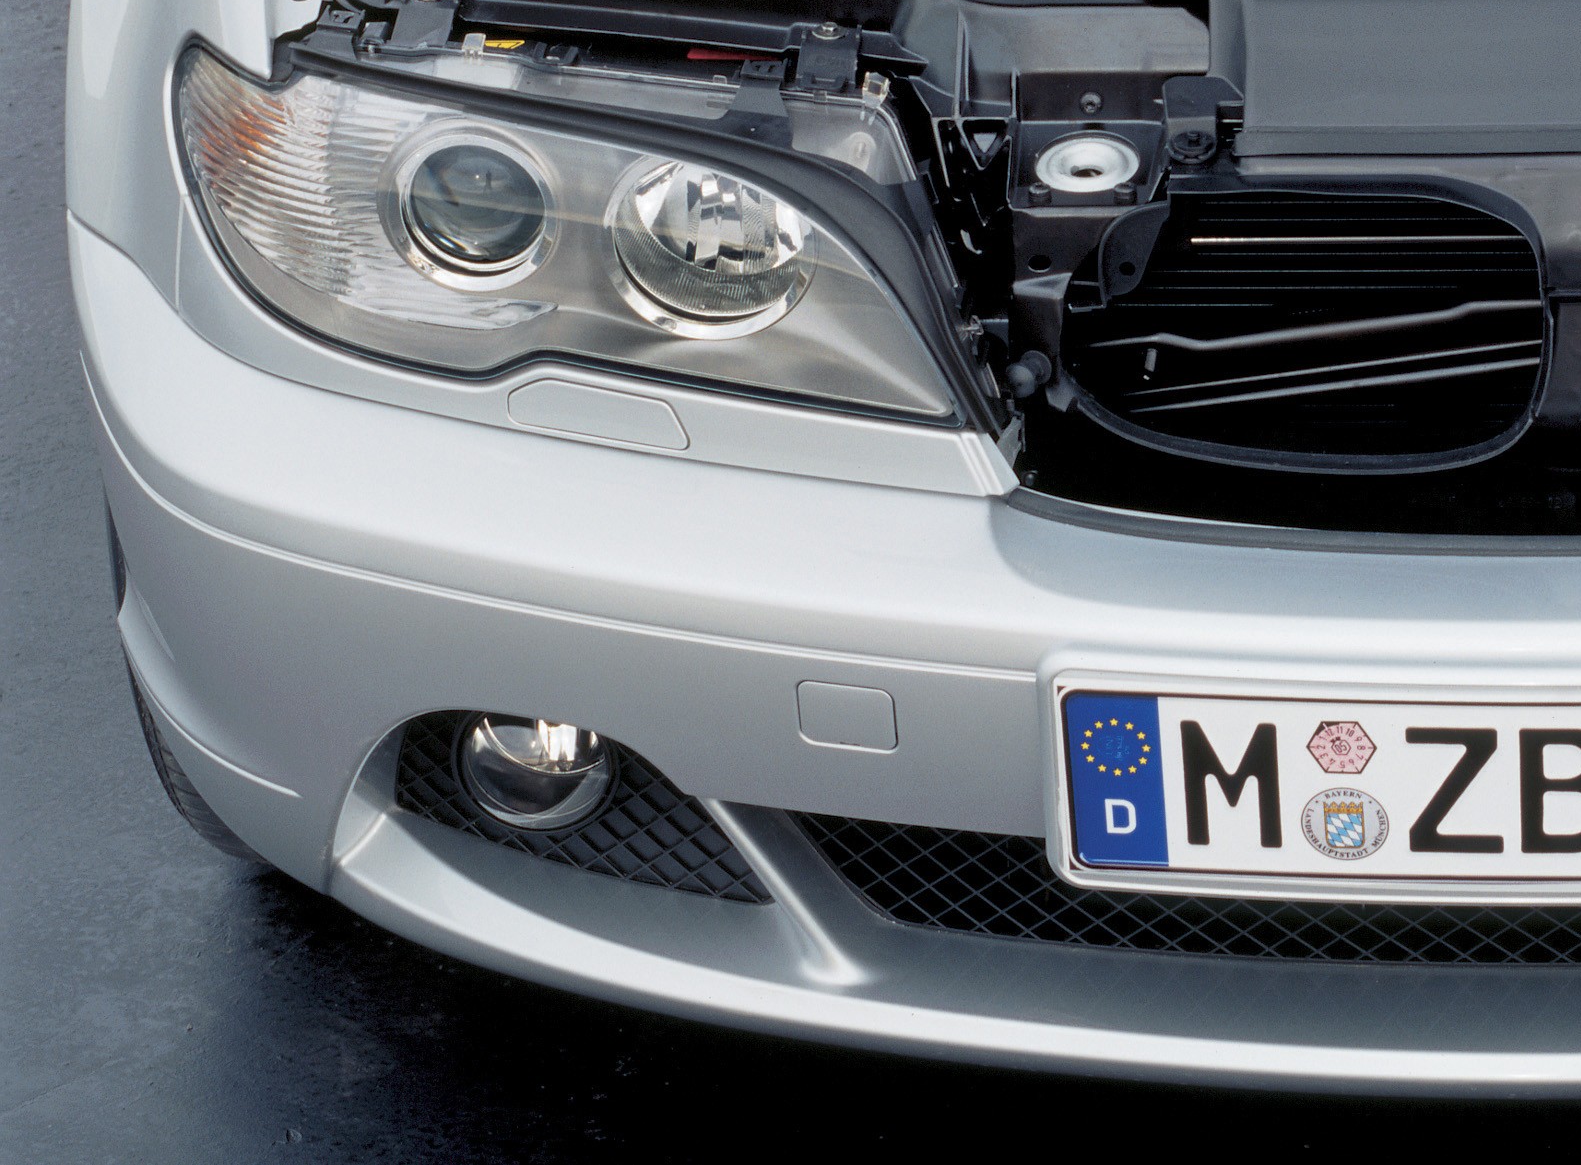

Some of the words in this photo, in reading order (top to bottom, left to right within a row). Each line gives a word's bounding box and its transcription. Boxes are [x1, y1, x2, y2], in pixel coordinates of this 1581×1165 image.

[1345, 727, 1355, 737] 10
[1180, 720, 1282, 848] M
[1324, 790, 1362, 799] BAYERN
[1105, 799, 1137, 834] D
[1304, 808, 1368, 858] LANDESHAUPTSTADT
[1371, 809, 1386, 847] MÜNCHEN
